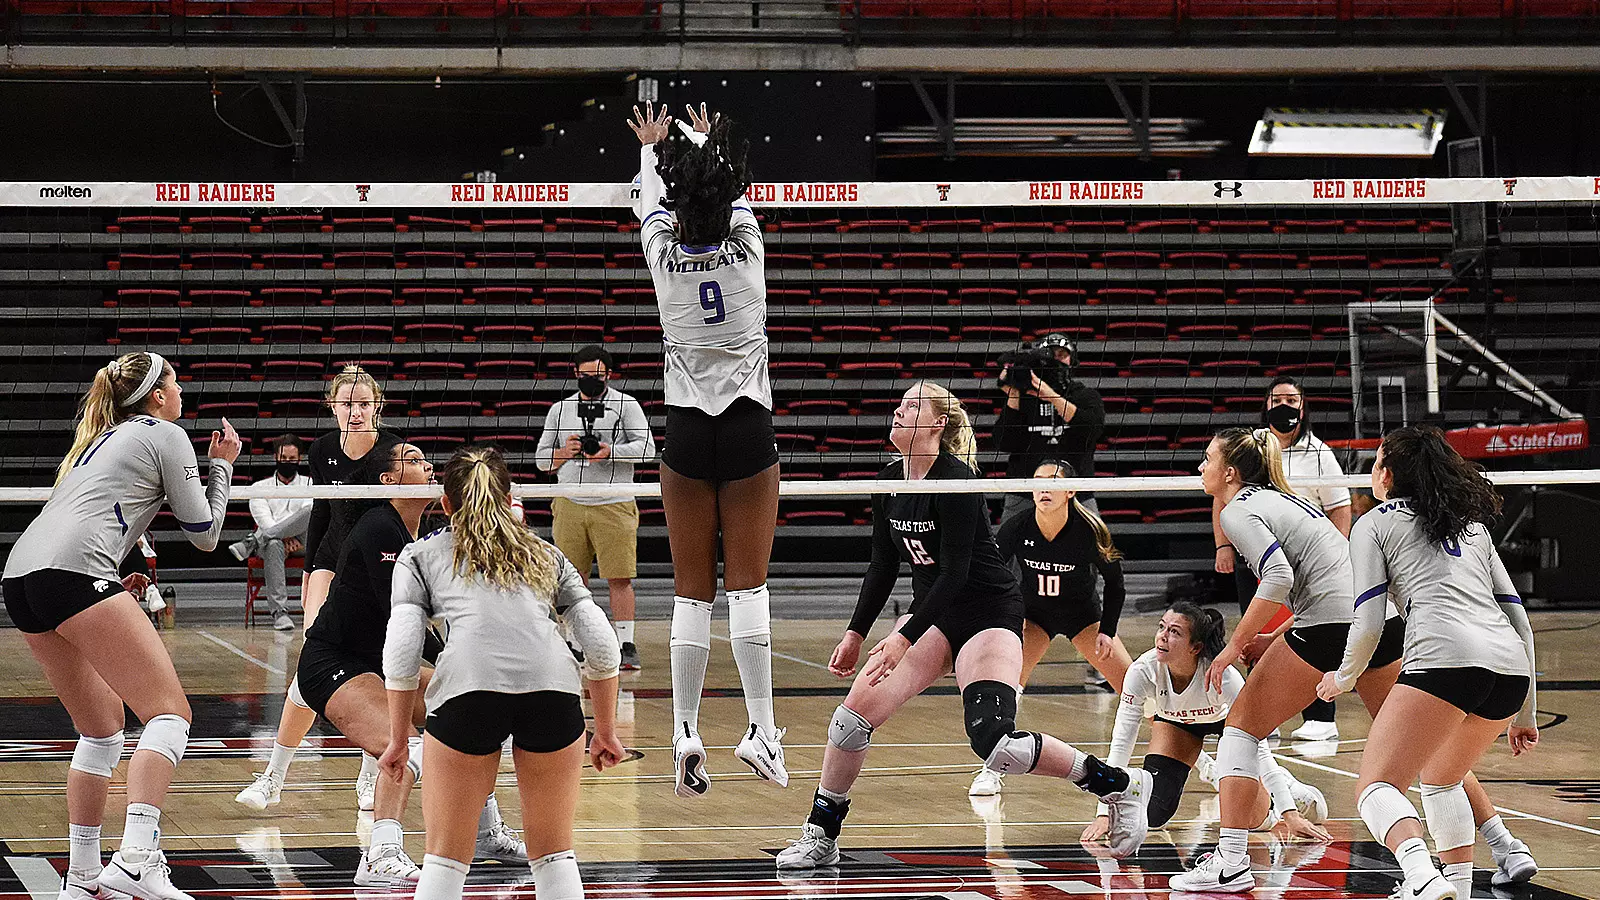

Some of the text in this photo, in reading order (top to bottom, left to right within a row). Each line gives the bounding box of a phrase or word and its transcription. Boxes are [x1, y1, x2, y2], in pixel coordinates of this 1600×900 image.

[39, 185, 92, 198] molten
[155, 184, 275, 202] RED RAIDERS
[451, 185, 569, 202] RED RAIDERS
[783, 184, 858, 202] RAIDERS
[1029, 182, 1143, 200] RED RAIDERS
[1313, 180, 1426, 198] RED RAIDERS
[699, 281, 726, 325] 9
[890, 519, 936, 533] TEXAS TECH
[902, 536, 936, 565] 12
[1024, 559, 1076, 572] TEXAS TECH
[1037, 573, 1060, 596] 10
[1190, 707, 1215, 717] TECH
